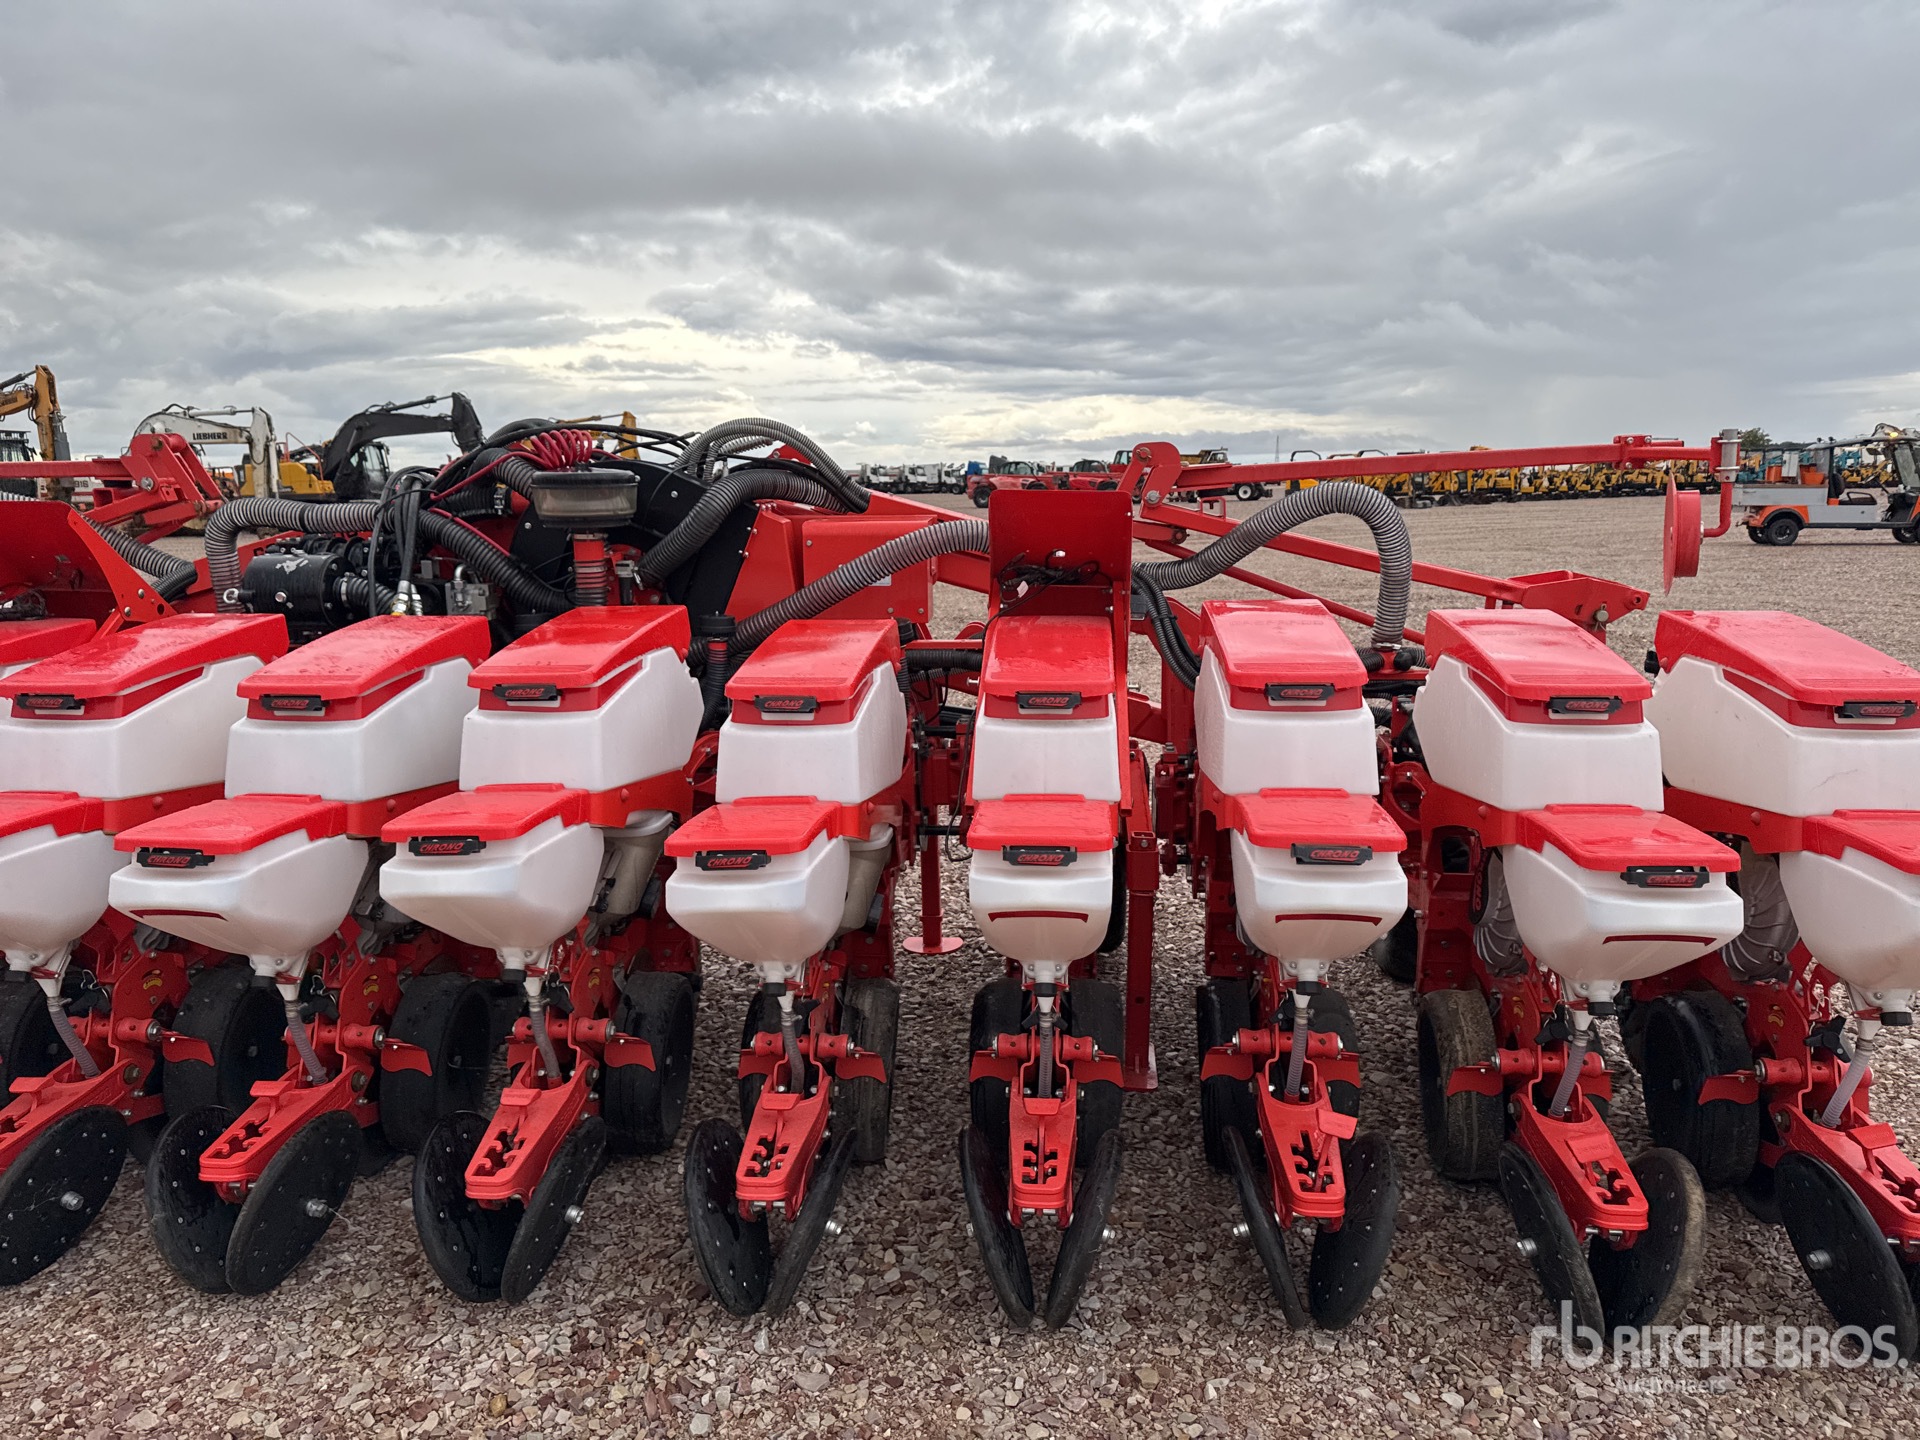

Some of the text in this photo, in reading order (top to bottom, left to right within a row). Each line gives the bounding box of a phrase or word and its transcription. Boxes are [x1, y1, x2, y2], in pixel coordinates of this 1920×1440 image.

[192, 431, 228, 440] LIEBHERR
[505, 688, 545, 697] CHRONO
[1280, 688, 1324, 698] CHRONO
[271, 699, 310, 708] CHRONO
[764, 700, 804, 709] CHRONO
[1028, 697, 1070, 706] CHRONO
[1565, 701, 1610, 711] CHRONO
[1860, 706, 1906, 716] CHRONO
[419, 842, 465, 853] CHRONO
[1017, 854, 1065, 865] CHRONO
[1310, 849, 1360, 861] CHRONO
[147, 855, 191, 866] CHRONO
[707, 856, 752, 868] CHRONO
[1646, 875, 1698, 886] CHRONO
